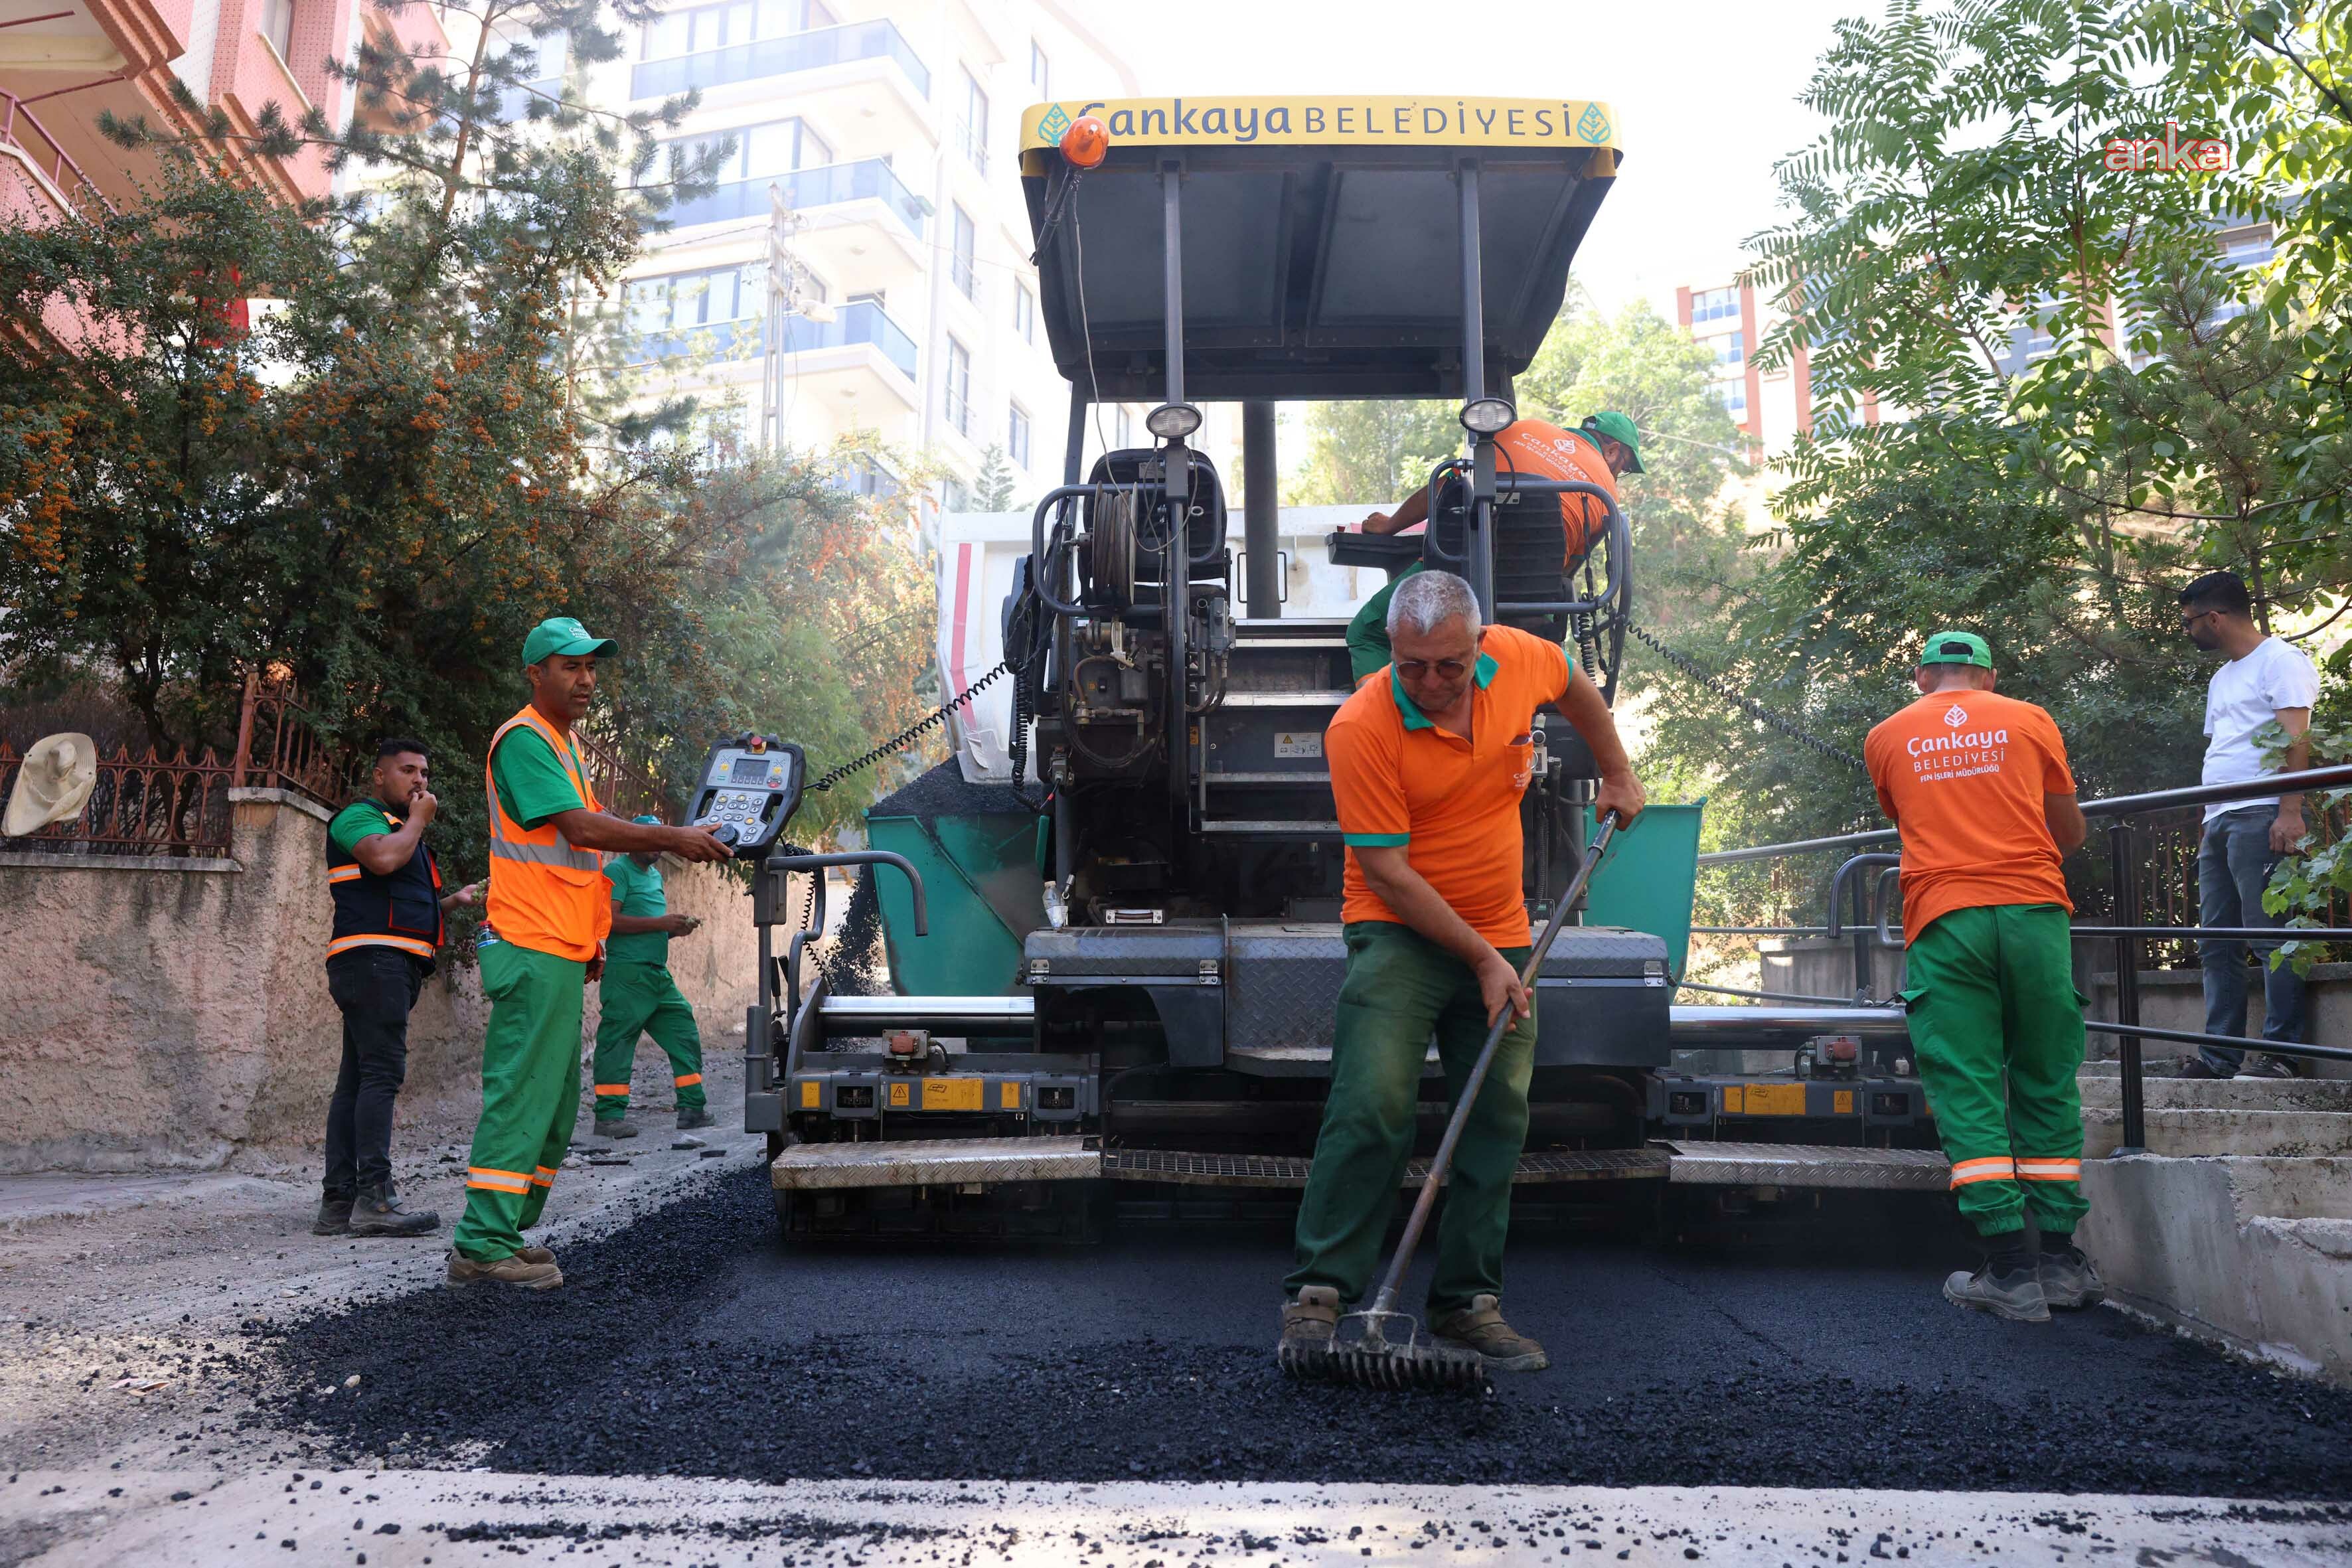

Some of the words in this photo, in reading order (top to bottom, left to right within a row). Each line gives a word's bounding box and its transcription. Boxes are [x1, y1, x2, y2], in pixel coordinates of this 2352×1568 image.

[1305, 101, 1571, 137] BELEDİYESİ
[1907, 729, 2009, 757] Çankaya
[1914, 747, 2004, 773] BELEDİYESİ
[1934, 770, 1954, 781] İŞLERİ
[1956, 764, 1999, 778] MÜDÜRLÜĞÜ
